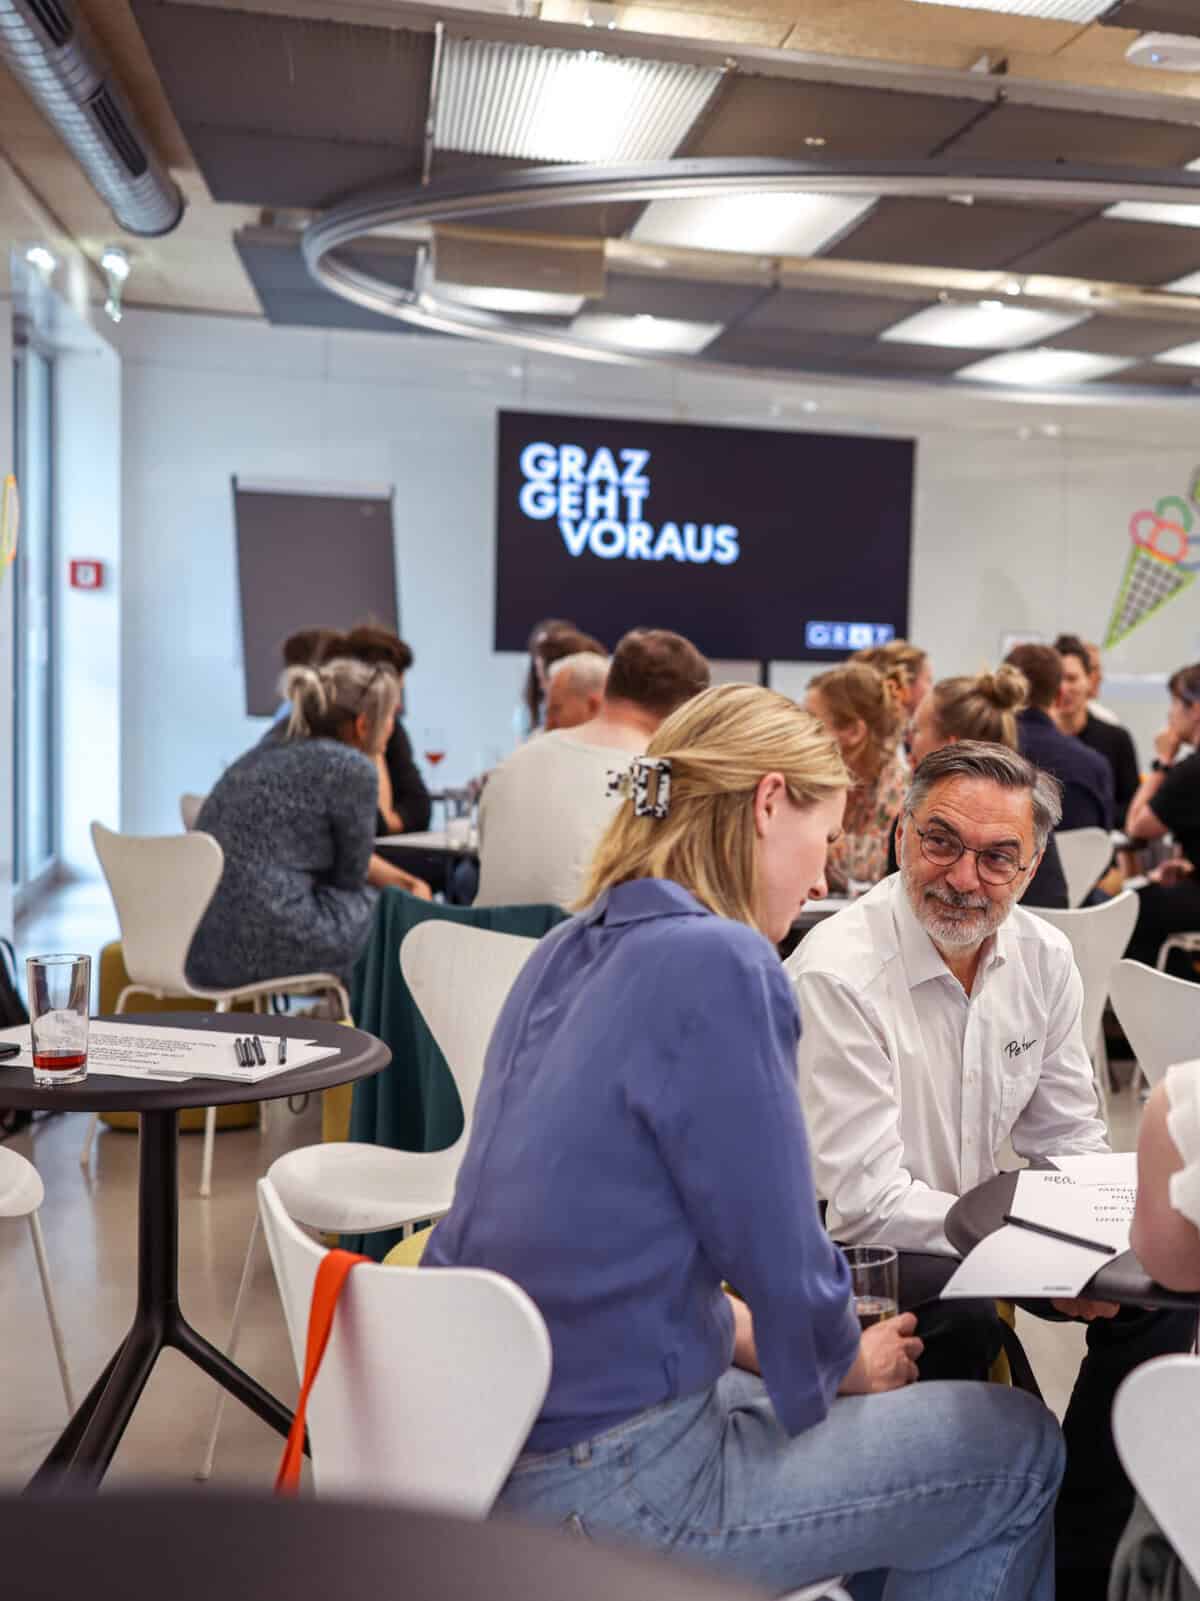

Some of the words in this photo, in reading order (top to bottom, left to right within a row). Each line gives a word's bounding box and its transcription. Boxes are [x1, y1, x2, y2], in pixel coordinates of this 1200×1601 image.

[519, 442, 651, 487] GRAZ
[519, 481, 651, 520] GEHT
[558, 518, 740, 565] VORAUS
